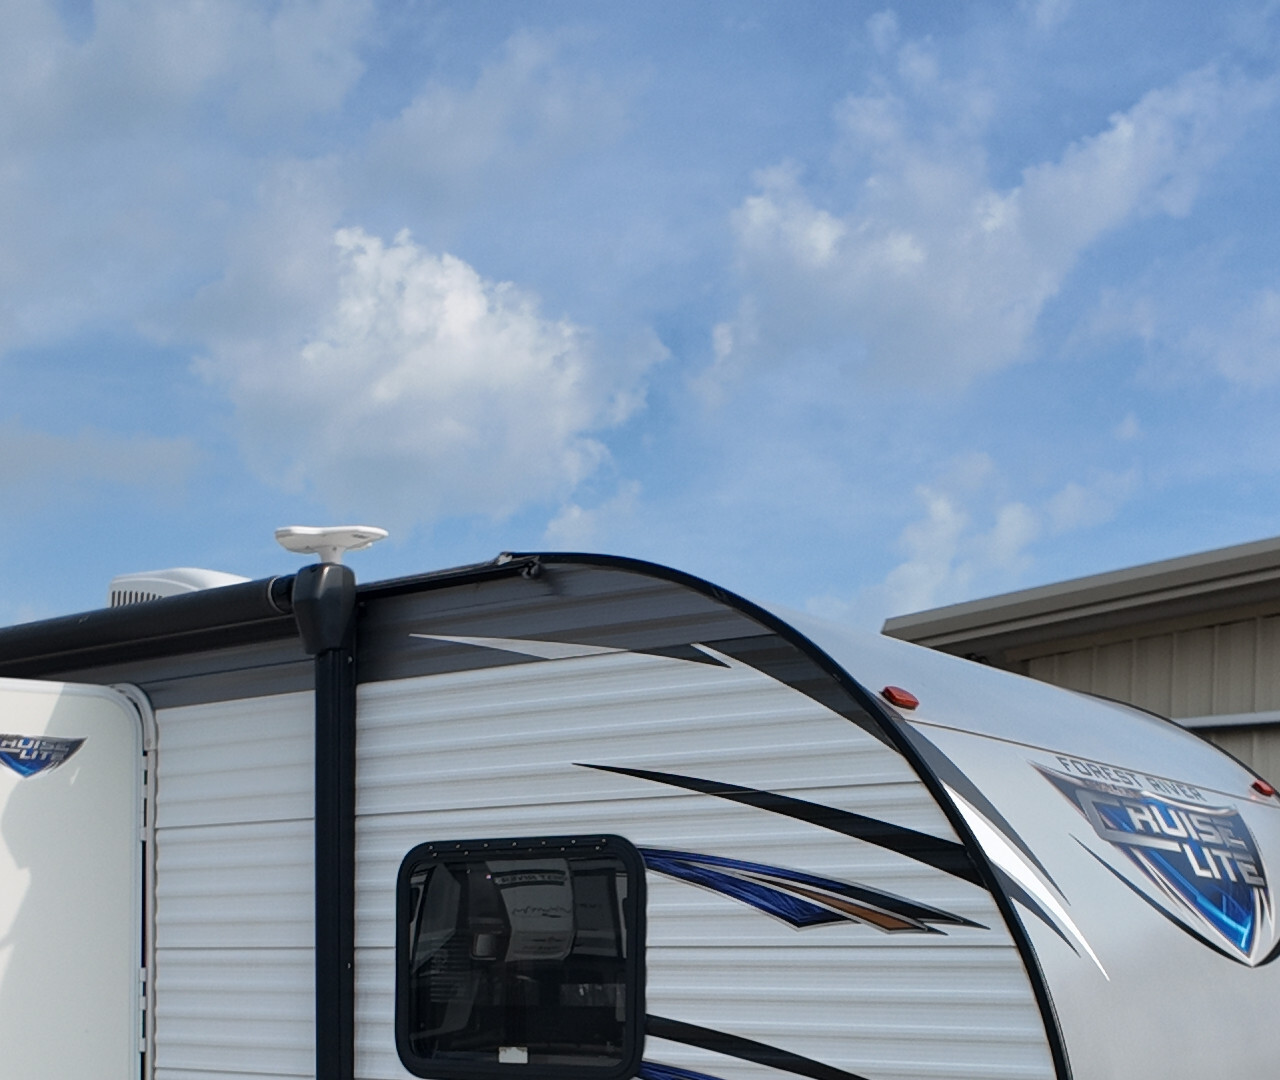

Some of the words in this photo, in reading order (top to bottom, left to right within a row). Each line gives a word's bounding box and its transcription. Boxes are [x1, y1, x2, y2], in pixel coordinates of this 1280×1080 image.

[1055, 755, 1145, 789] FOREST
[1144, 776, 1207, 802] RIVER
[1074, 789, 1248, 853] CRUISE
[1183, 842, 1266, 888] LITE
